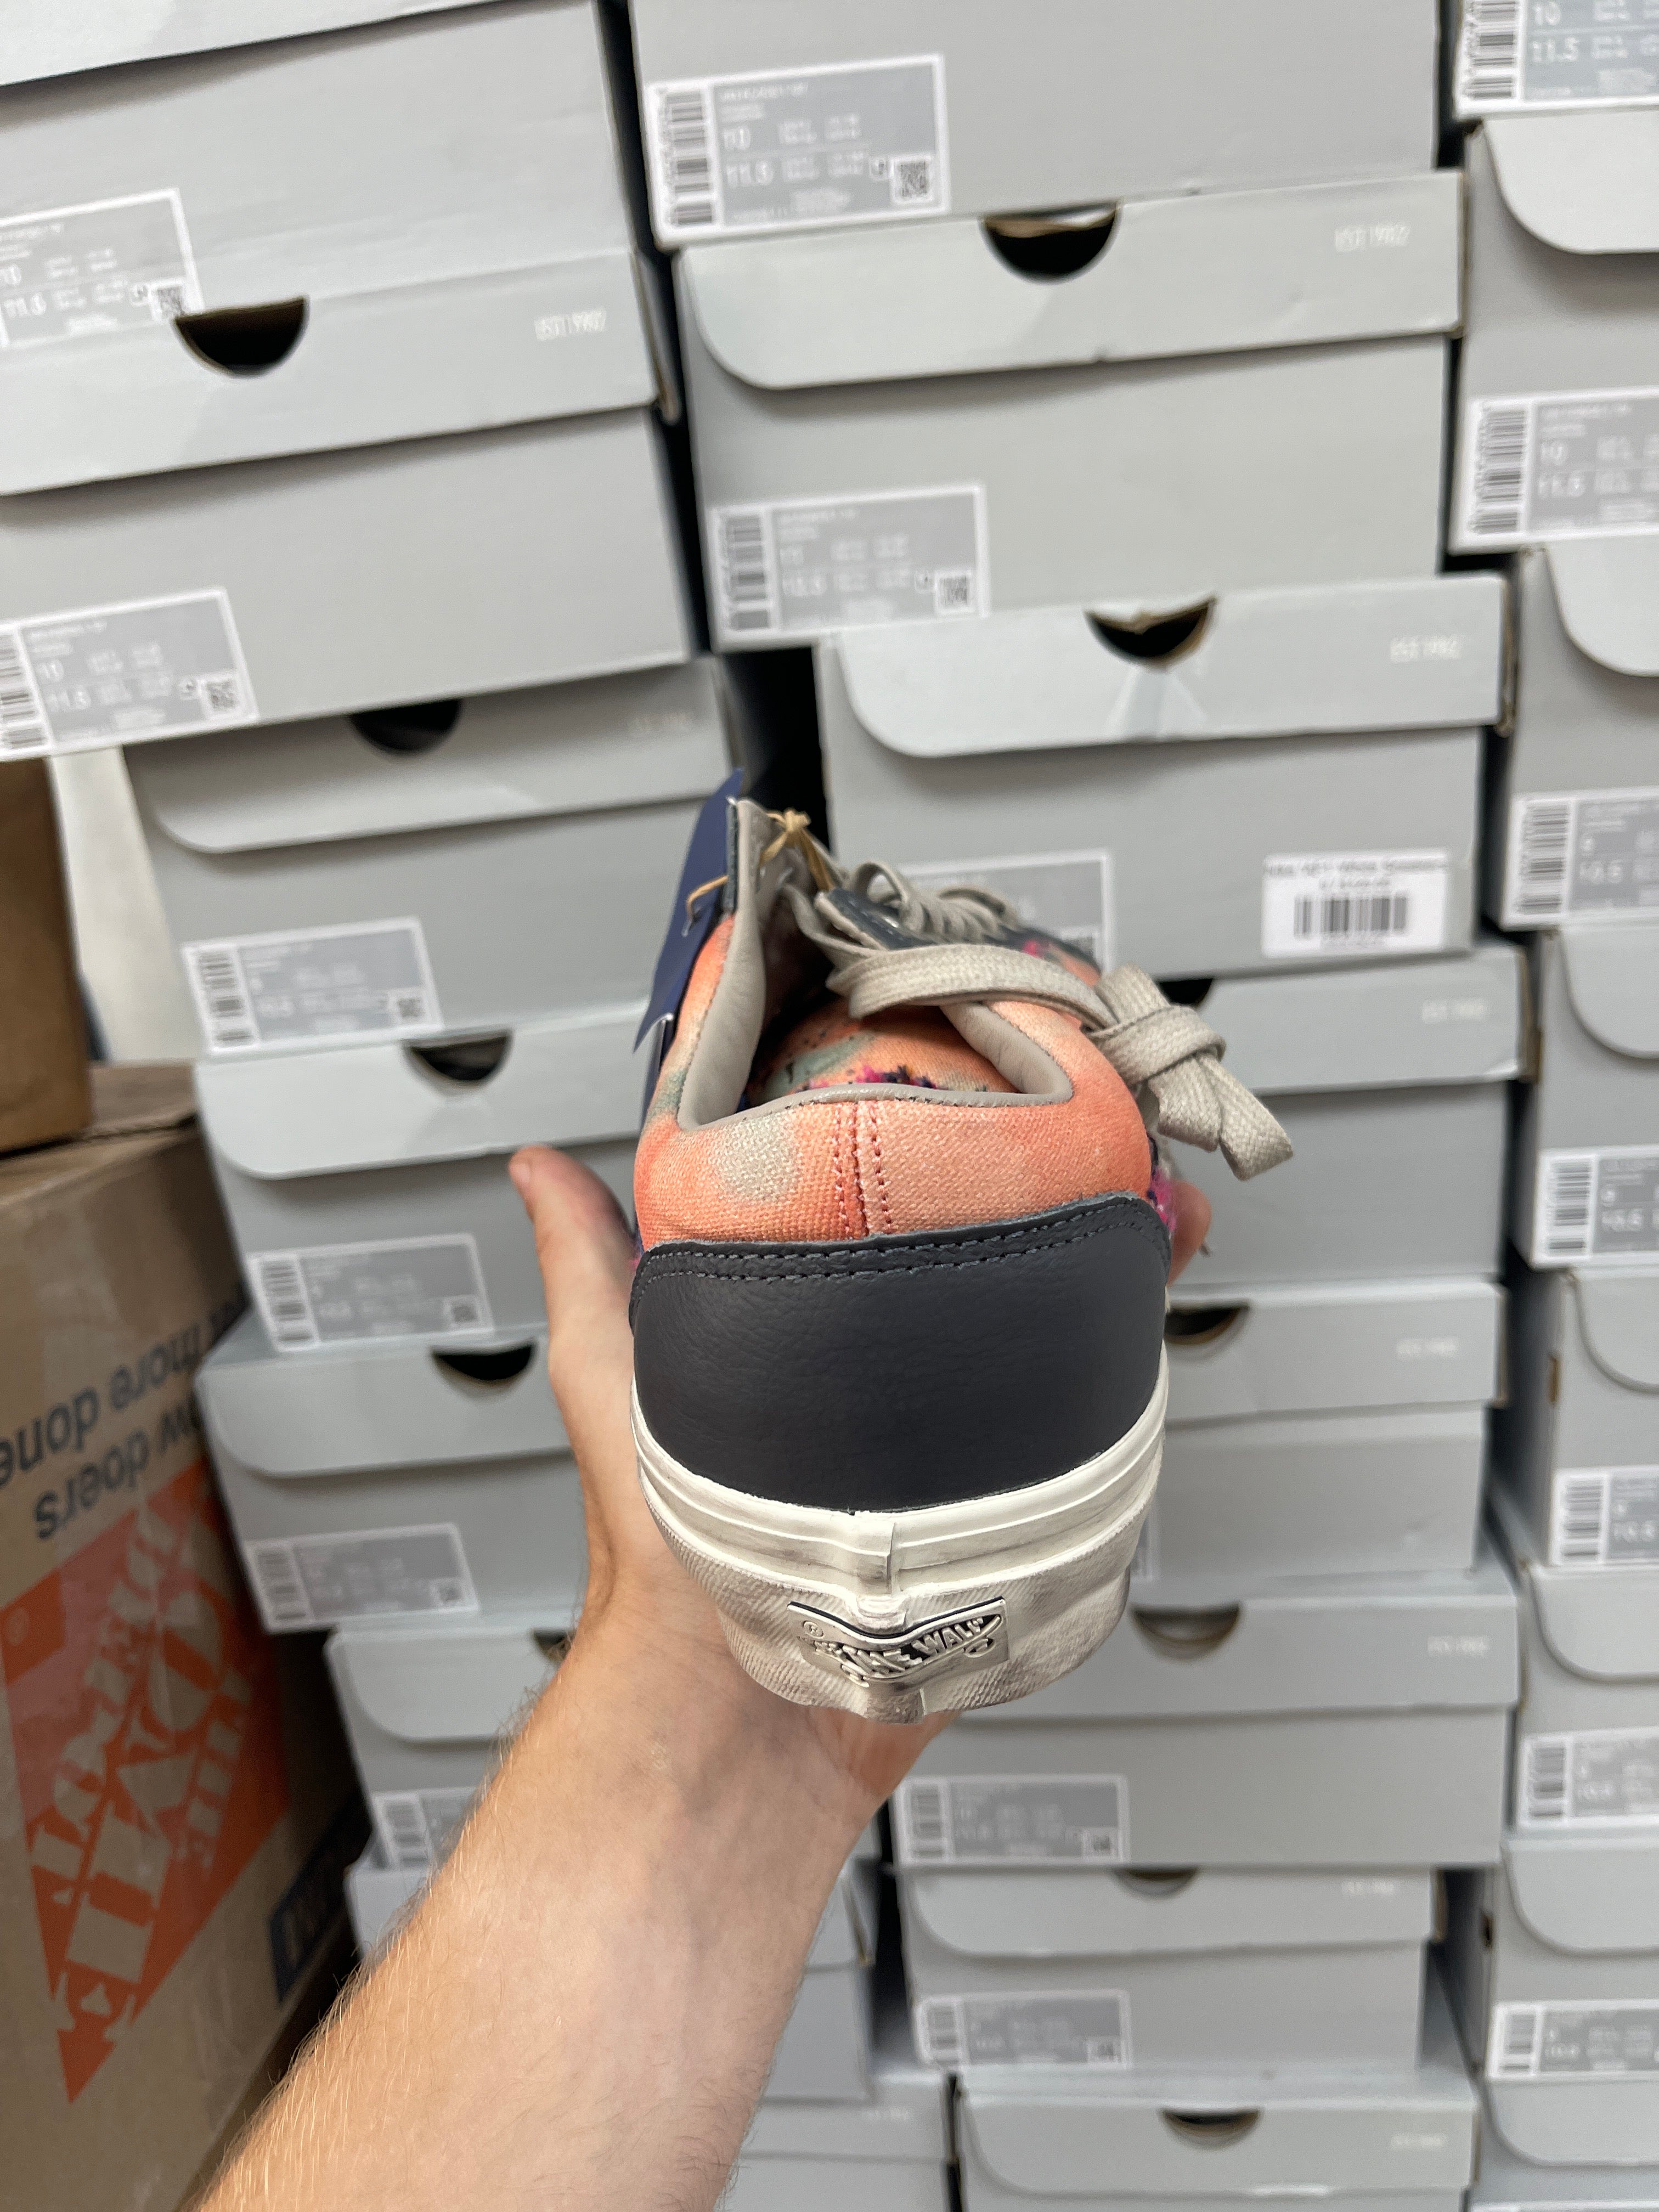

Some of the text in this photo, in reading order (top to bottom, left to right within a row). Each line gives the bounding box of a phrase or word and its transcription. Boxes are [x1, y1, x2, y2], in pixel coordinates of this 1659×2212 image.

[1533, 2, 1561, 26] 10
[111, 1323, 201, 1412] more
[33, 1429, 150, 1541] doers
